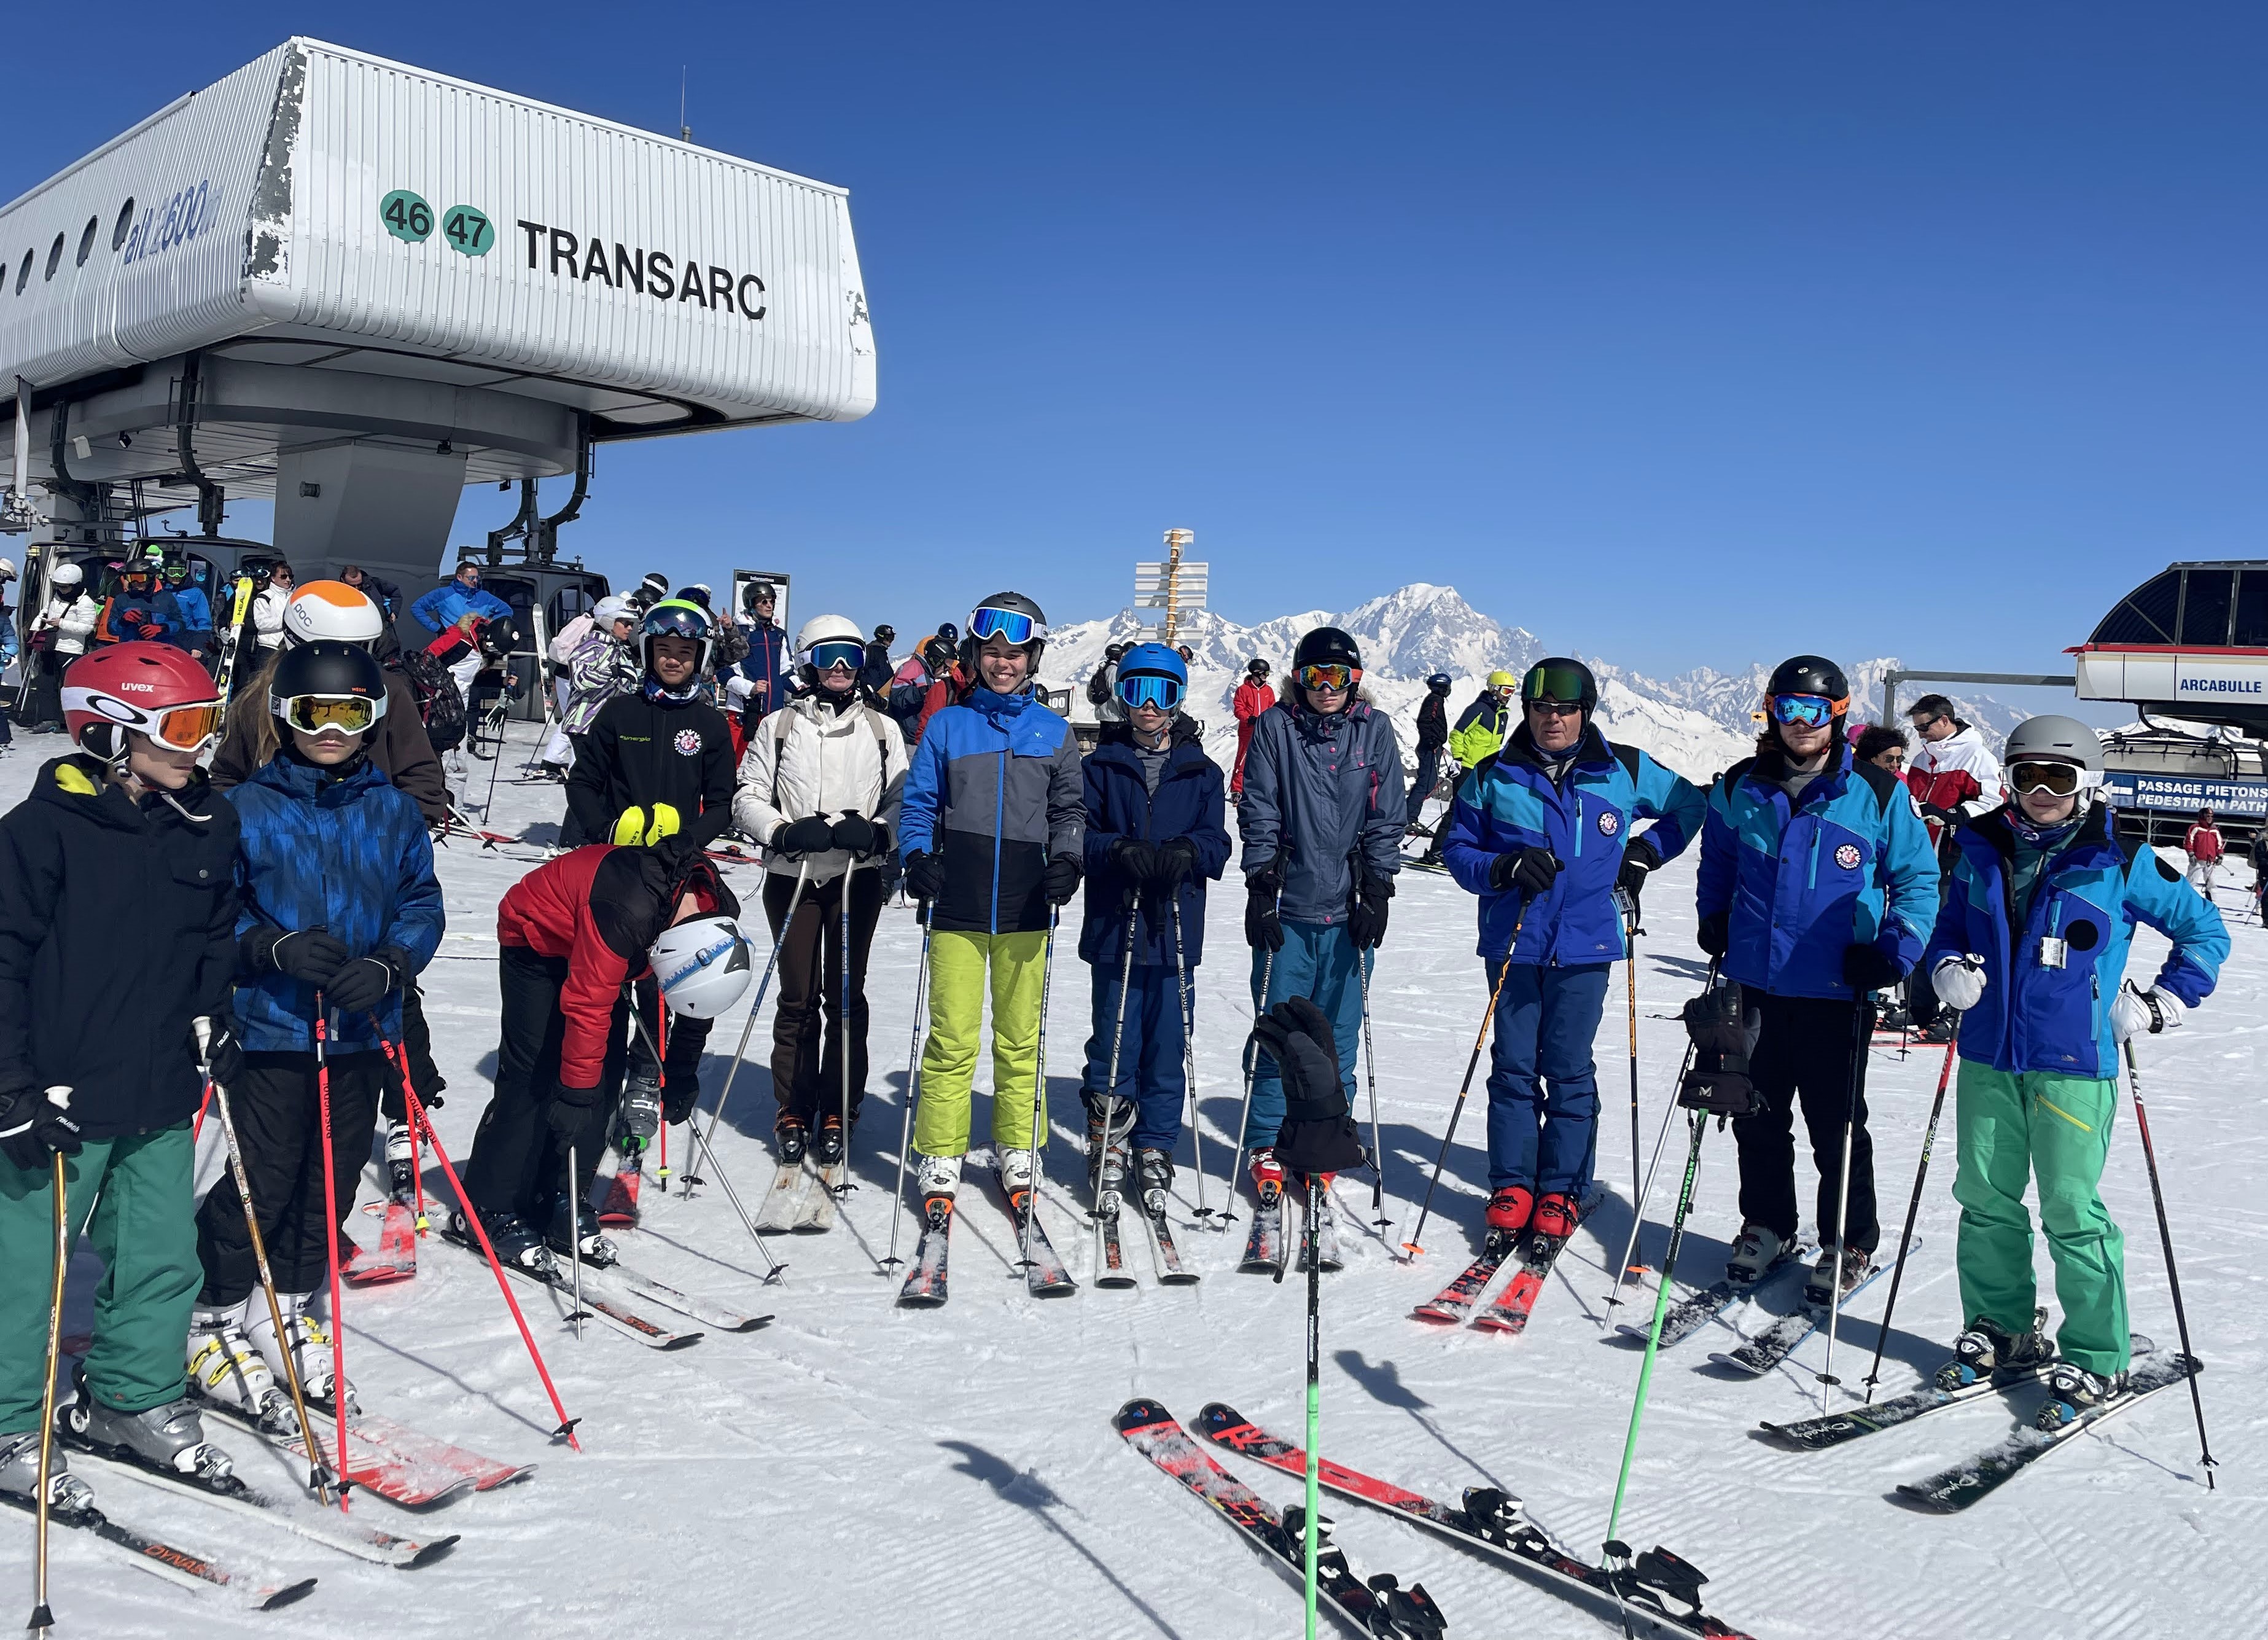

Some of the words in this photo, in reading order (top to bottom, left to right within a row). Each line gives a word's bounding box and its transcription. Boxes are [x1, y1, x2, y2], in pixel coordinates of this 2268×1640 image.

[385, 198, 431, 236] 46
[446, 213, 486, 248] 47
[516, 219, 767, 320] TRANSARC
[121, 682, 154, 693] uvex
[2180, 679, 2262, 693] ARCABULLE
[2137, 780, 2202, 795] PASSAGE
[2205, 784, 2268, 799] PIETONS
[2136, 793, 2226, 810] PEDESTRIAN
[2229, 800, 2268, 813] PATH
[2129, 1068, 2144, 1105] LEKI
